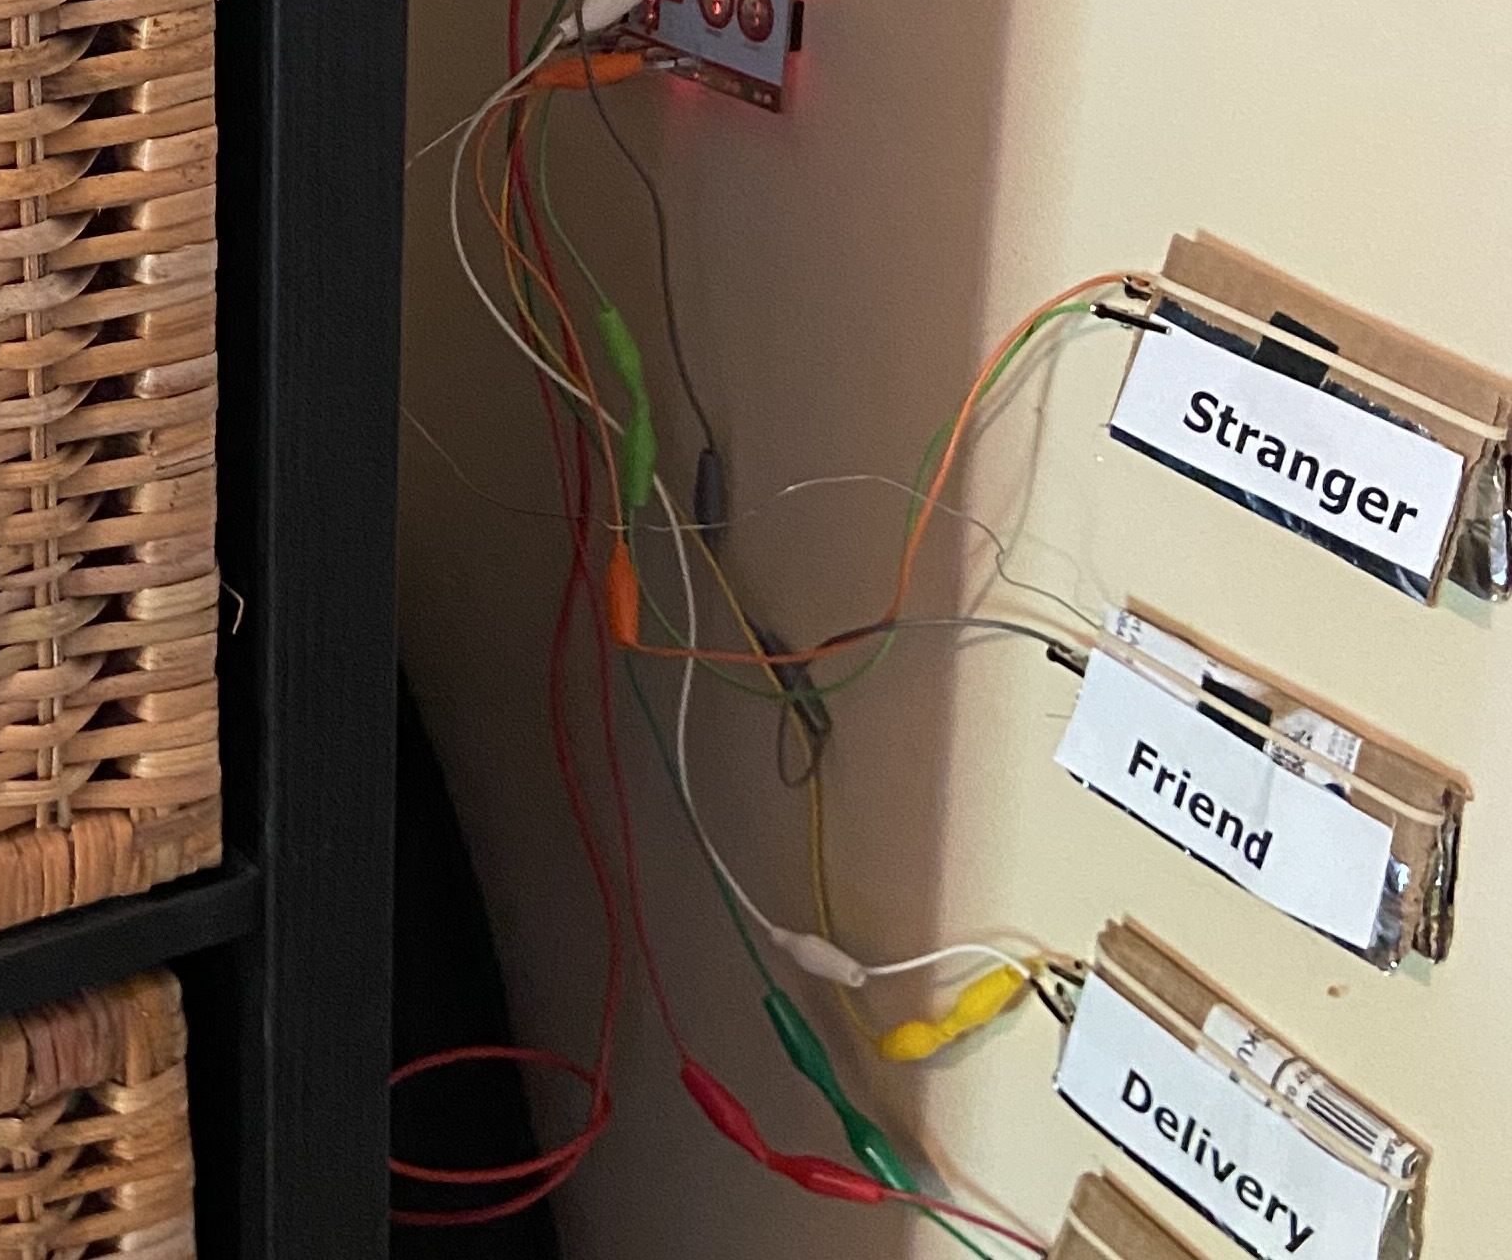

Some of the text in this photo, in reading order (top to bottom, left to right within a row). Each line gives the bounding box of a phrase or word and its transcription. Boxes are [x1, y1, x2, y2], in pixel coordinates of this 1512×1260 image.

[1184, 391, 1418, 533] Stranger
[1129, 741, 1272, 881] Friend
[1122, 1070, 1313, 1253] Delivery
